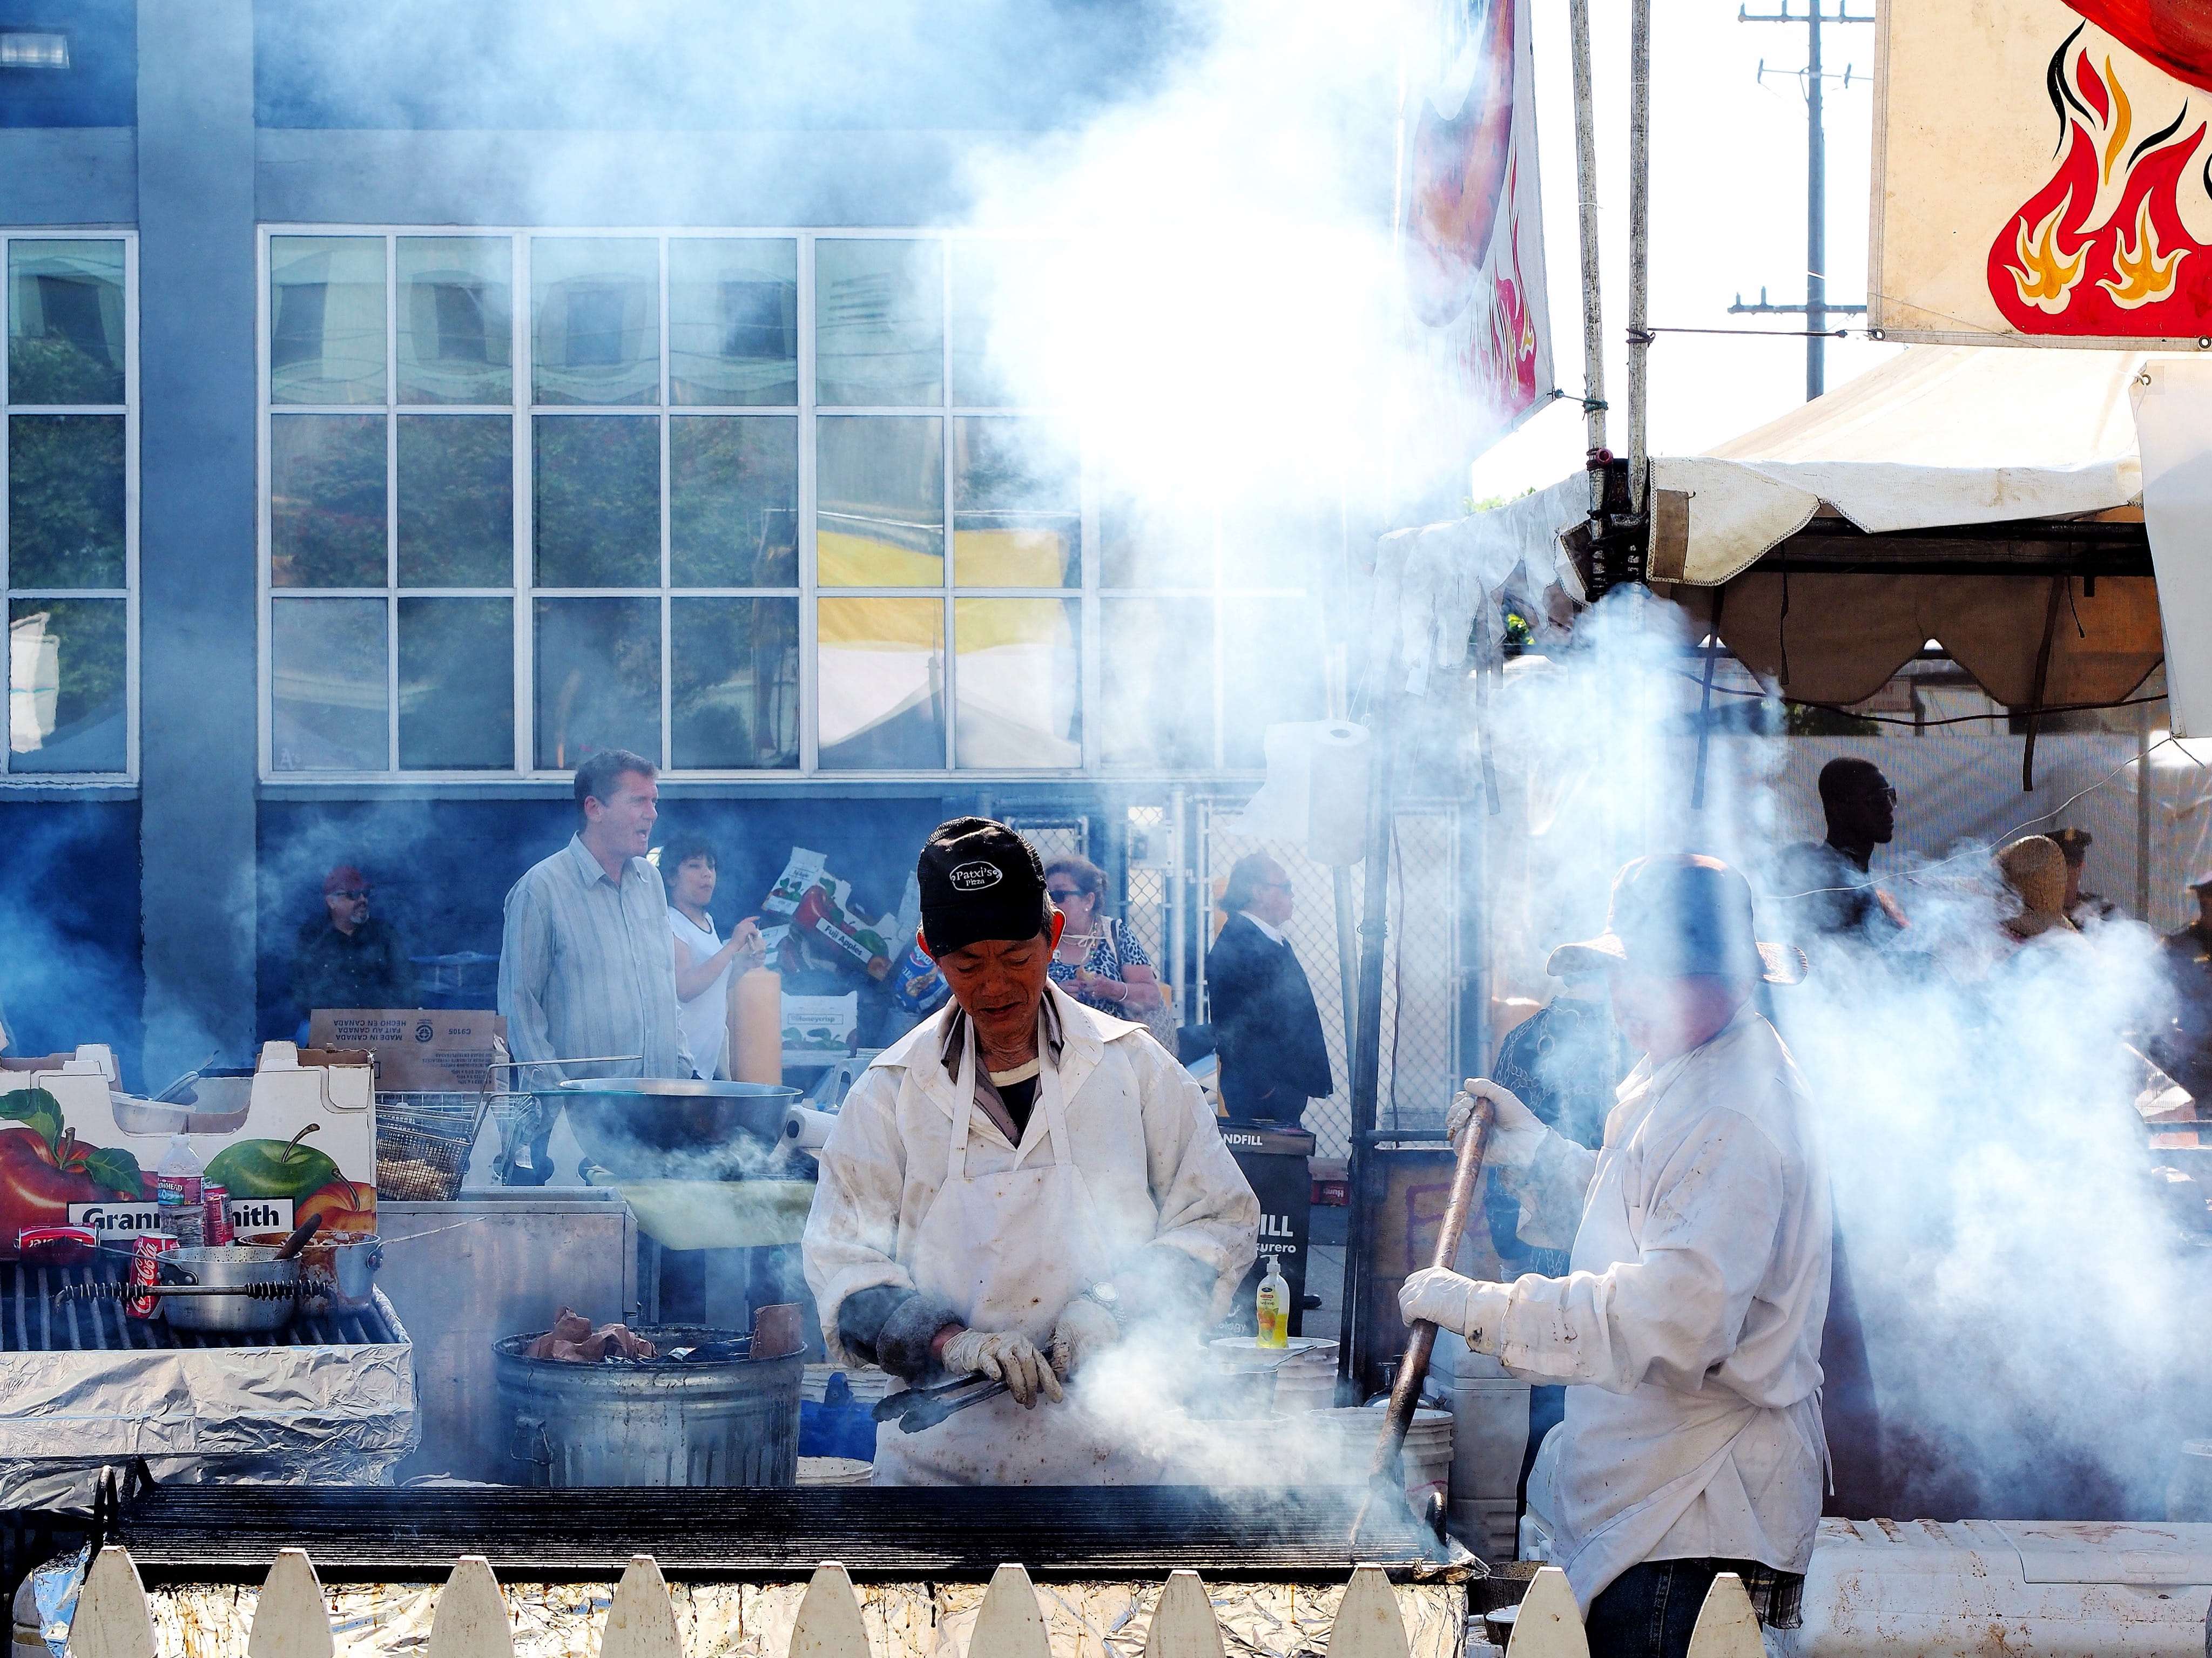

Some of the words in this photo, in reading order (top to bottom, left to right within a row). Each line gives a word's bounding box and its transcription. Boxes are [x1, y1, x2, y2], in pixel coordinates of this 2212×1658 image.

[956, 867, 992, 881] Patxi's
[825, 925, 839, 939] Fuji
[838, 936, 862, 956] Apples
